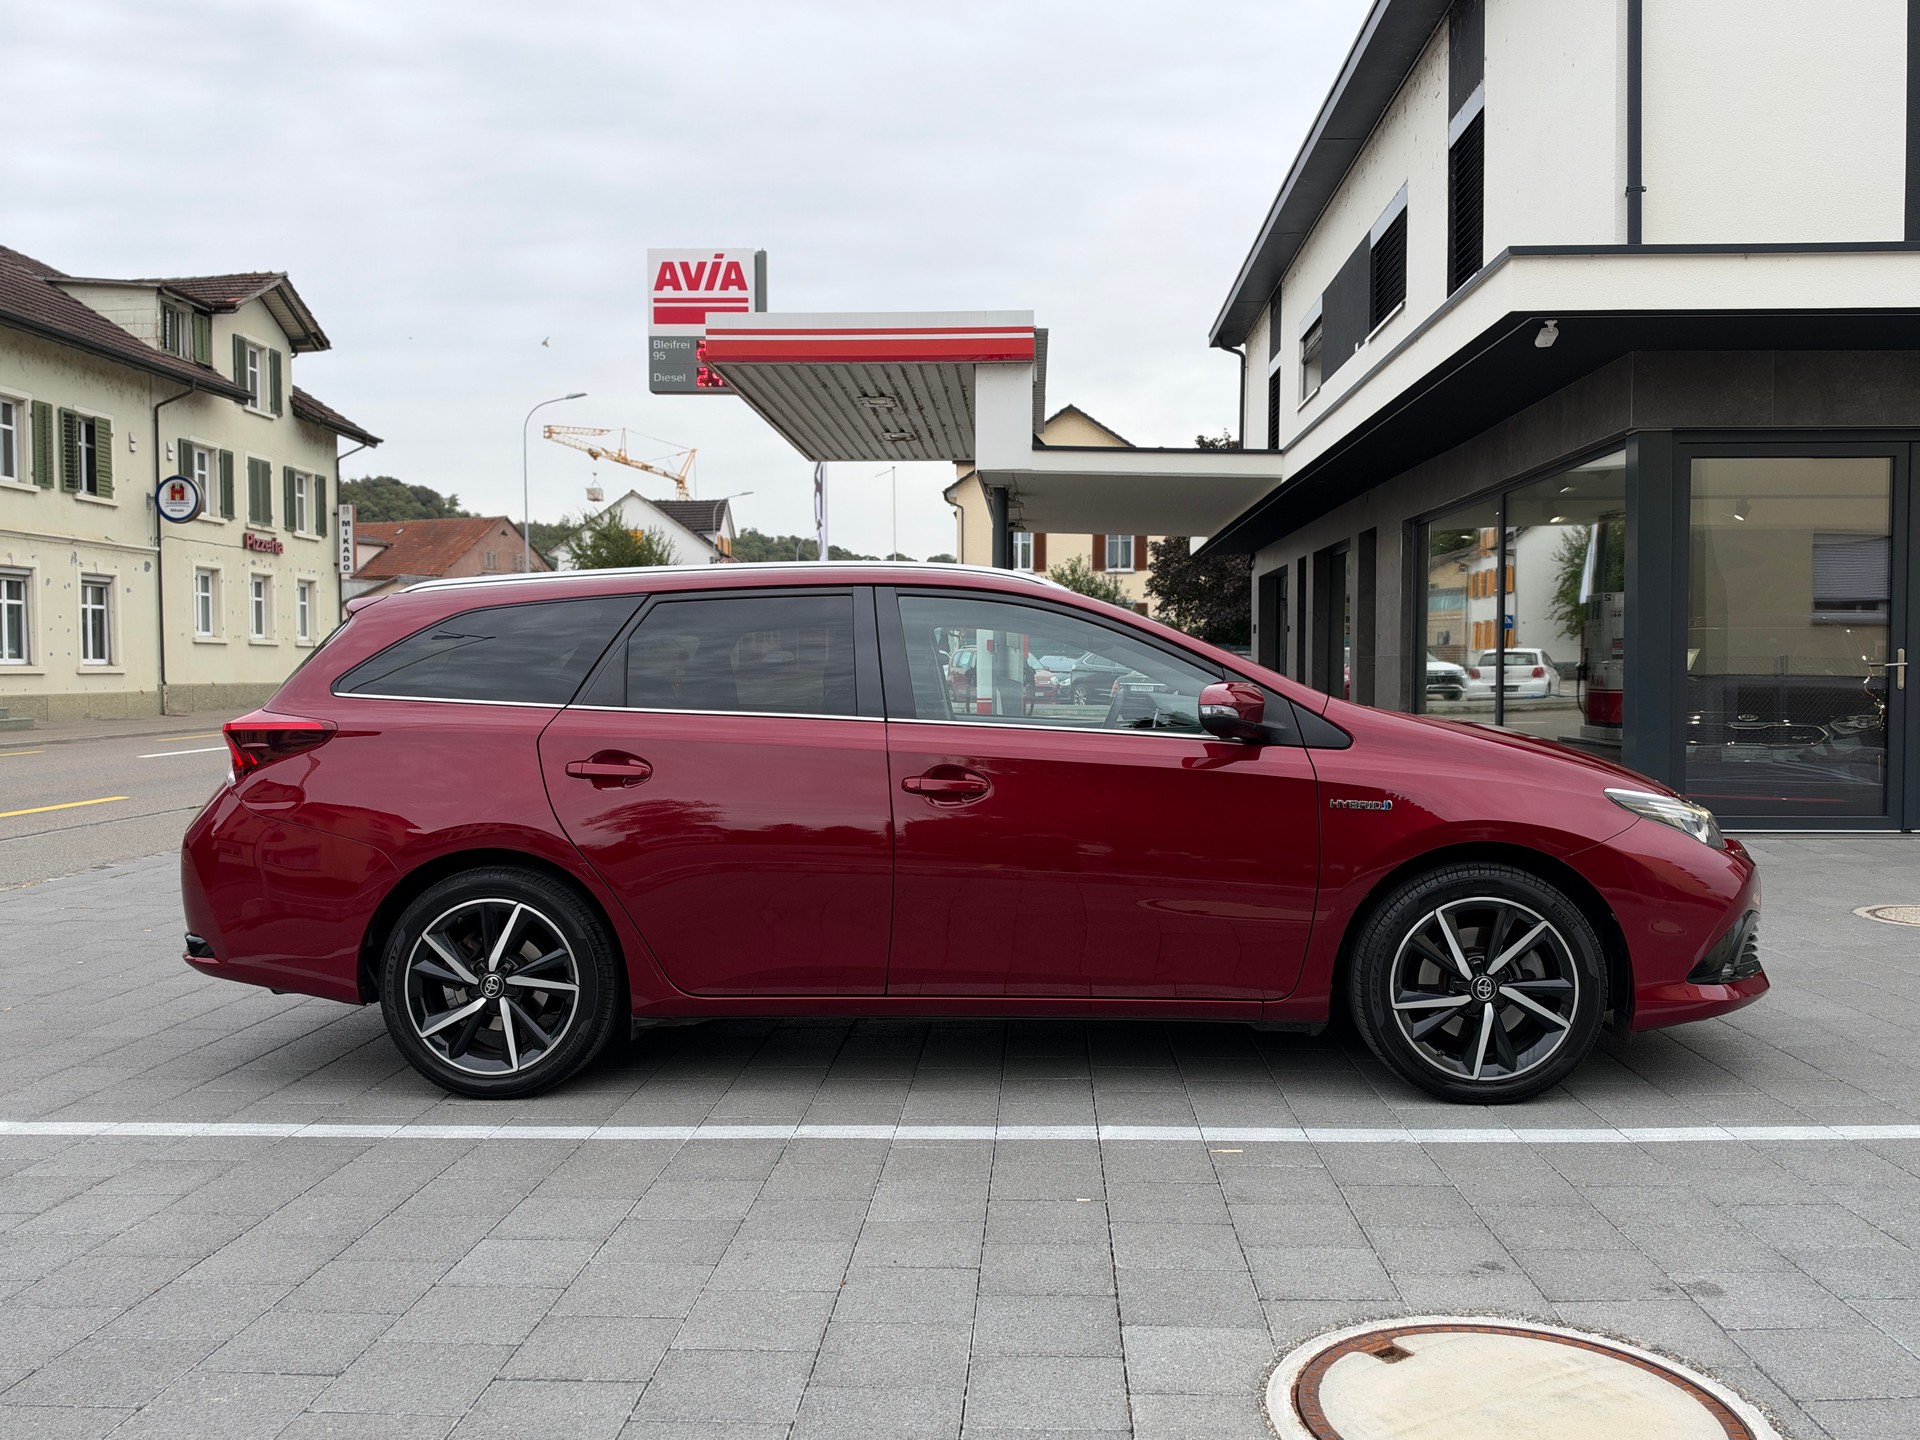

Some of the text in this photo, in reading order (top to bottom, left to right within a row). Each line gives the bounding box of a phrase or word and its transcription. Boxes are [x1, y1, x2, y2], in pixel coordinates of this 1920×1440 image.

[653, 340, 690, 349] Bleifrei
[653, 352, 666, 360] 95
[653, 373, 686, 382] Diesel
[246, 533, 283, 554] Pizzeria
[341, 520, 351, 571] MIKADO
[1330, 799, 1382, 809] HYBRID
